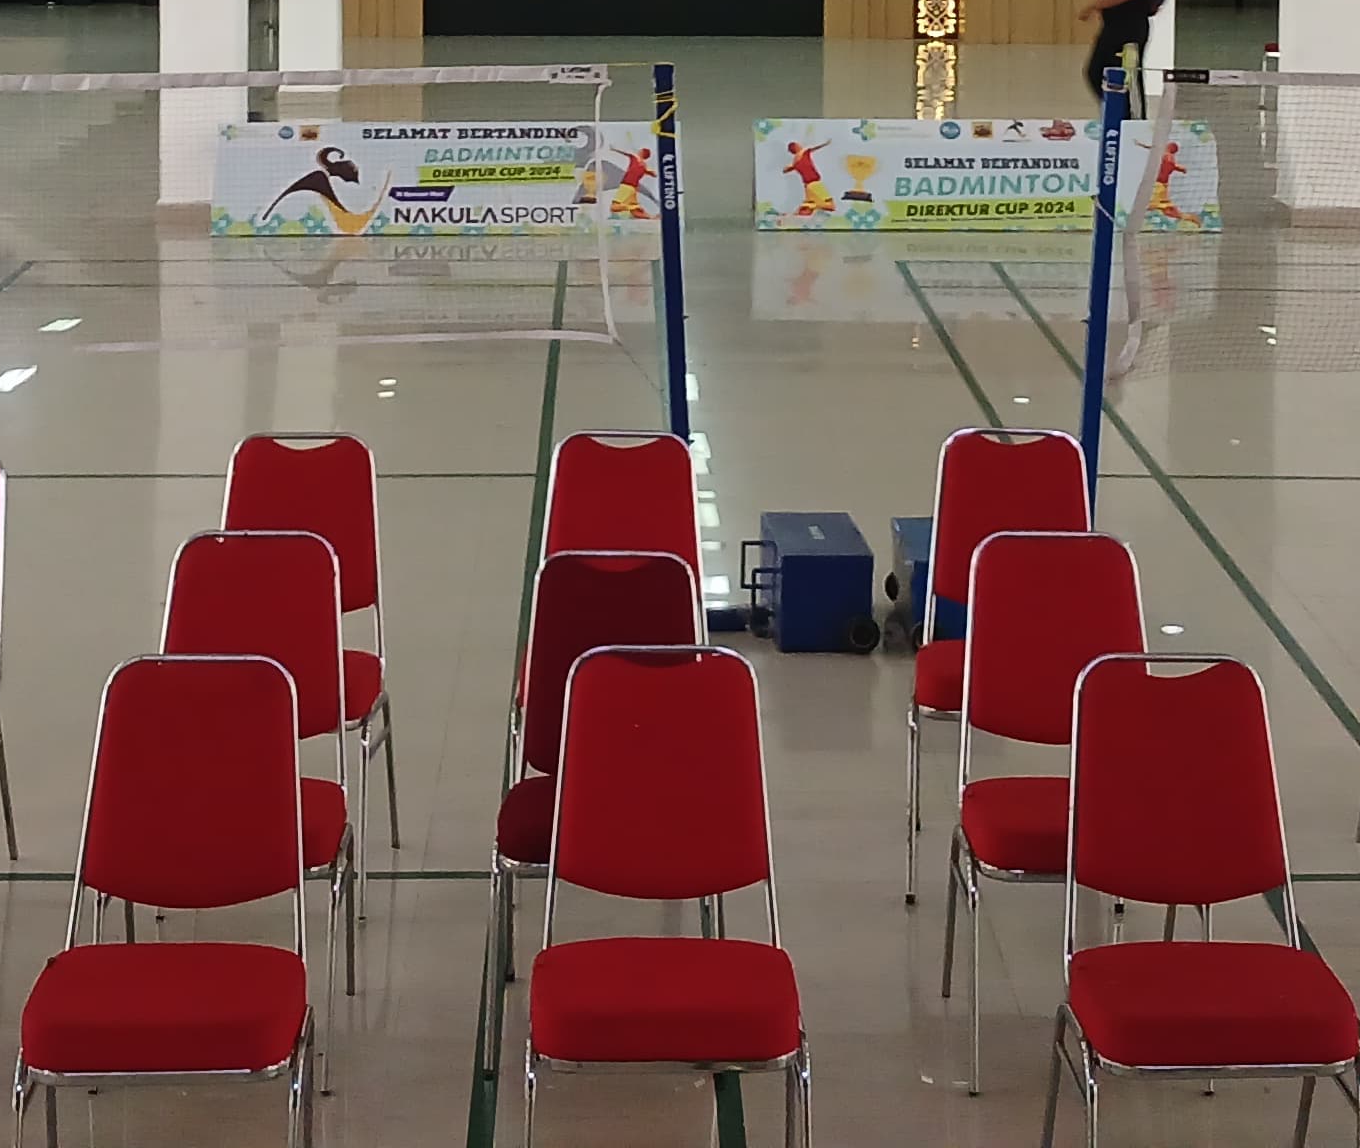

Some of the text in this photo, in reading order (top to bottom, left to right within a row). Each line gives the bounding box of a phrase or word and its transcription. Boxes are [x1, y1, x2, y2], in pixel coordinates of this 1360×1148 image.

[362, 128, 578, 140] SELAMAT BERTANDING
[424, 145, 576, 163] BADMINTON
[432, 167, 496, 178] DIREKTUR
[500, 166, 525, 177] CUP
[904, 158, 1079, 170] SELAMAT BERTANDING
[895, 173, 1090, 197] BADMINTON
[394, 206, 579, 224] NAKULASPORT
[906, 201, 1075, 217] DIREKTUR CUP 2024
